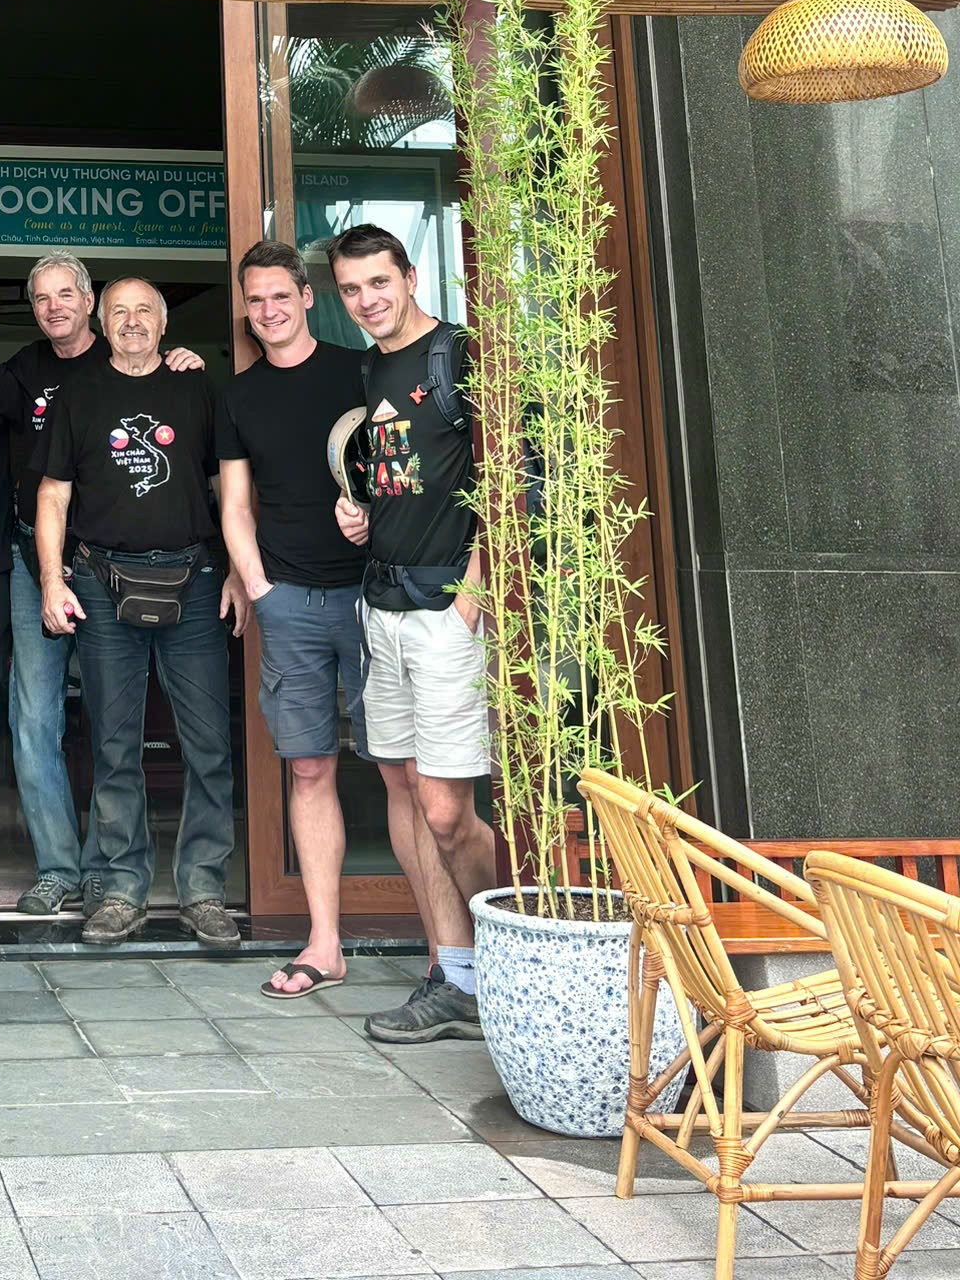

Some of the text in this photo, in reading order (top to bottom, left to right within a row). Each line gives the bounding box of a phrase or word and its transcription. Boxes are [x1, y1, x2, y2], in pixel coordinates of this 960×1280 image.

[13, 167, 47, 181] DỊCH
[51, 168, 69, 182] VỤ
[72, 168, 132, 181] THƯƠNG
[135, 170, 160, 184] MẠI
[164, 171, 182, 182] DU
[187, 171, 216, 185] LỊCH
[301, 174, 350, 186] ISLAND
[158, 188, 225, 219] OFF
[60, 222, 73, 231] as
[79, 222, 86, 231] a
[170, 224, 182, 233] as
[128, 465, 153, 474] 2025
